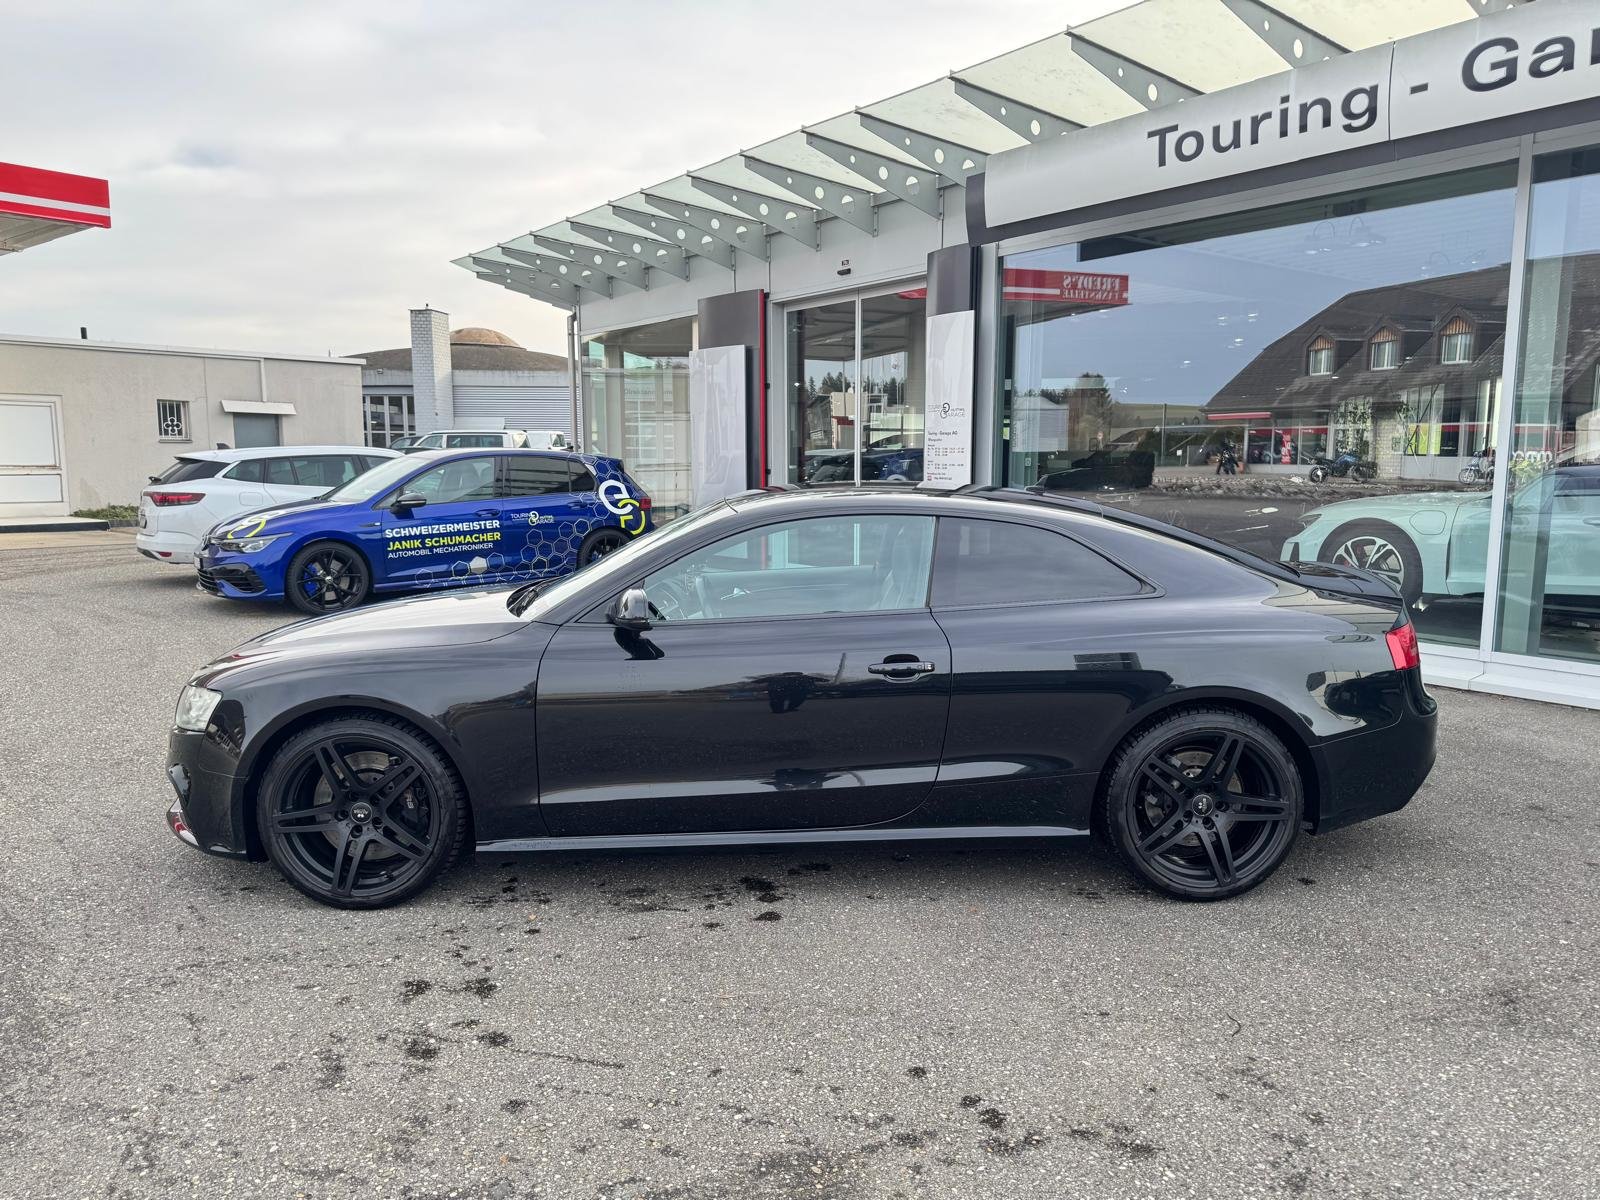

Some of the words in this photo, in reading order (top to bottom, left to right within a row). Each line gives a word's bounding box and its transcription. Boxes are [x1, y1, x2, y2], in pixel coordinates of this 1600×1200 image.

[1146, 82, 1380, 168] Touring
[1409, 82, 1430, 96] -
[1461, 27, 1600, 93] Ga
[385, 520, 500, 538] SCHWEIZERMEISTER
[387, 539, 422, 550] JANIK
[425, 532, 501, 547] SCHUMACHER
[388, 549, 432, 559] AUTOMOBIL
[433, 543, 494, 554] MECHATRONIKER
